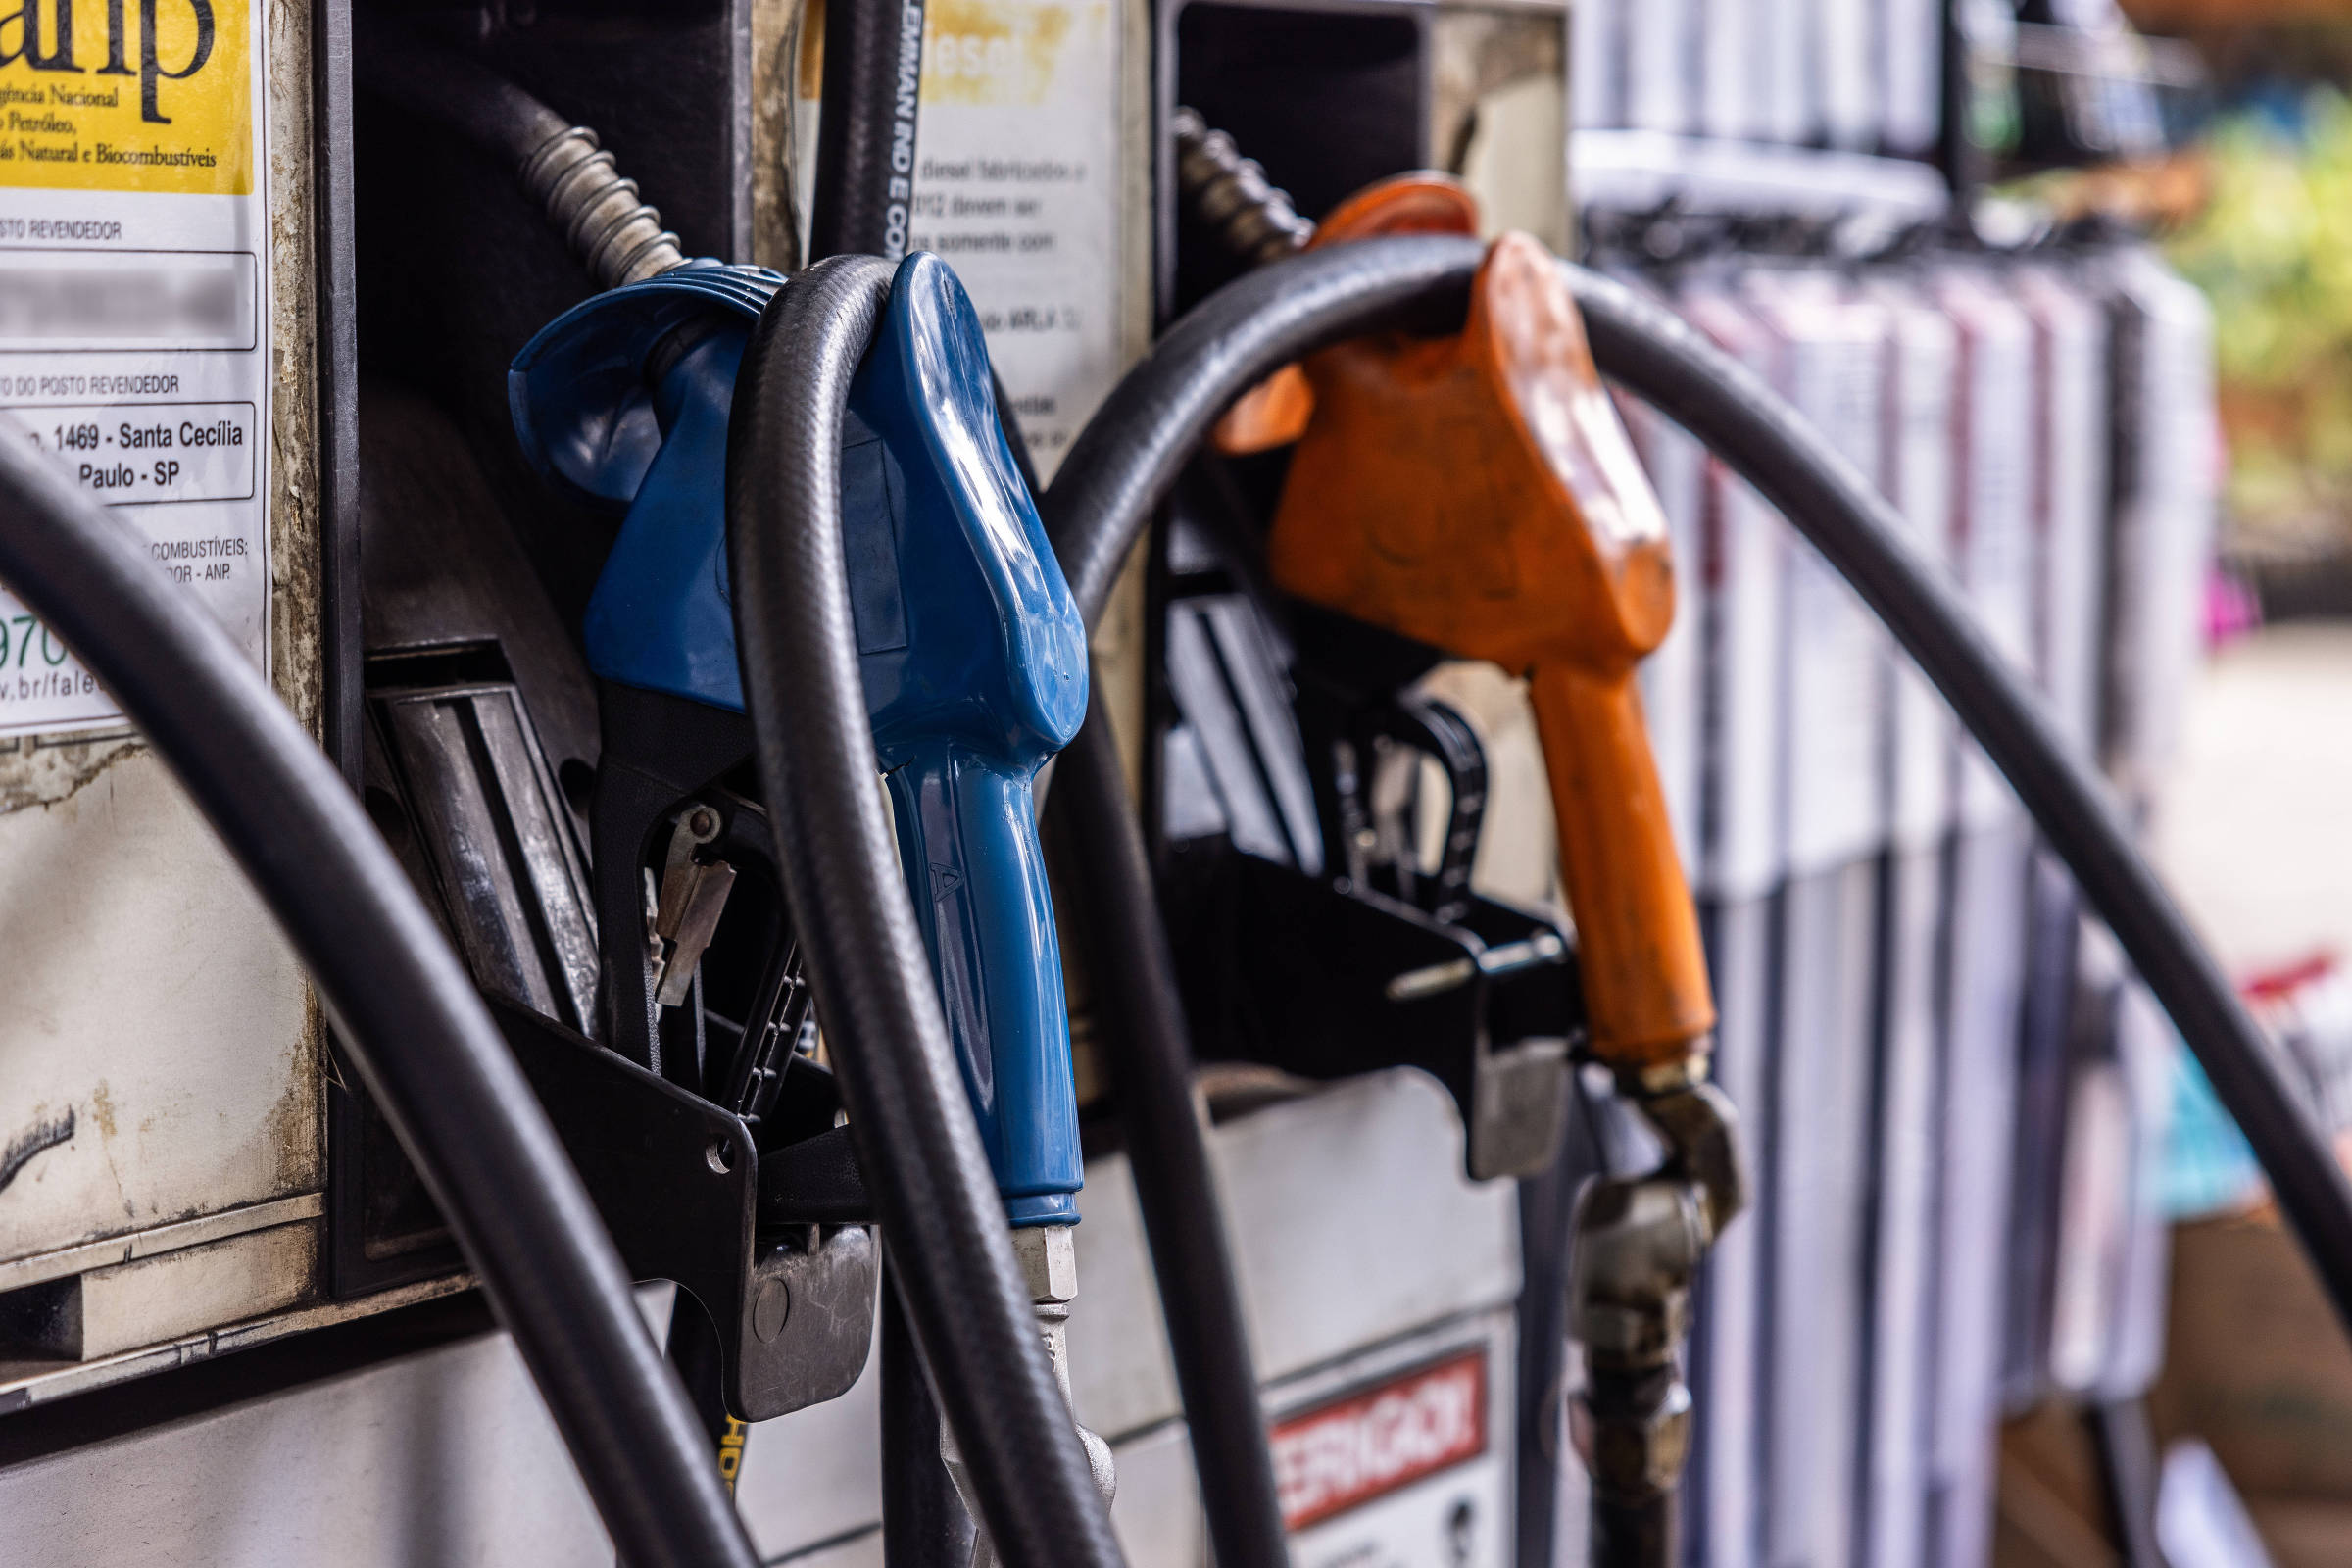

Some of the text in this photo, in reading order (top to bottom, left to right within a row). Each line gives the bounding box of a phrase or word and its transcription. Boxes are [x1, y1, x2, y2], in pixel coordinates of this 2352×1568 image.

[894, 0, 922, 118] EMMAN
[50, 84, 119, 107] Nacional
[9, 111, 76, 134] Petróleo,
[20, 140, 78, 163] Natural
[82, 149, 92, 162] e
[96, 143, 217, 167] Biocombustíveis
[29, 220, 122, 240] REVENDEDOR
[16, 376, 36, 396] DO
[40, 376, 87, 396] POSTO
[89, 375, 179, 395] REVENDEDOR
[54, 423, 99, 450] 1469
[120, 422, 172, 449] Santa
[179, 420, 243, 447] Cecília
[79, 461, 134, 489] Paulo
[155, 460, 179, 486] SP
[151, 535, 248, 561] COMBUSTÍVEIS:
